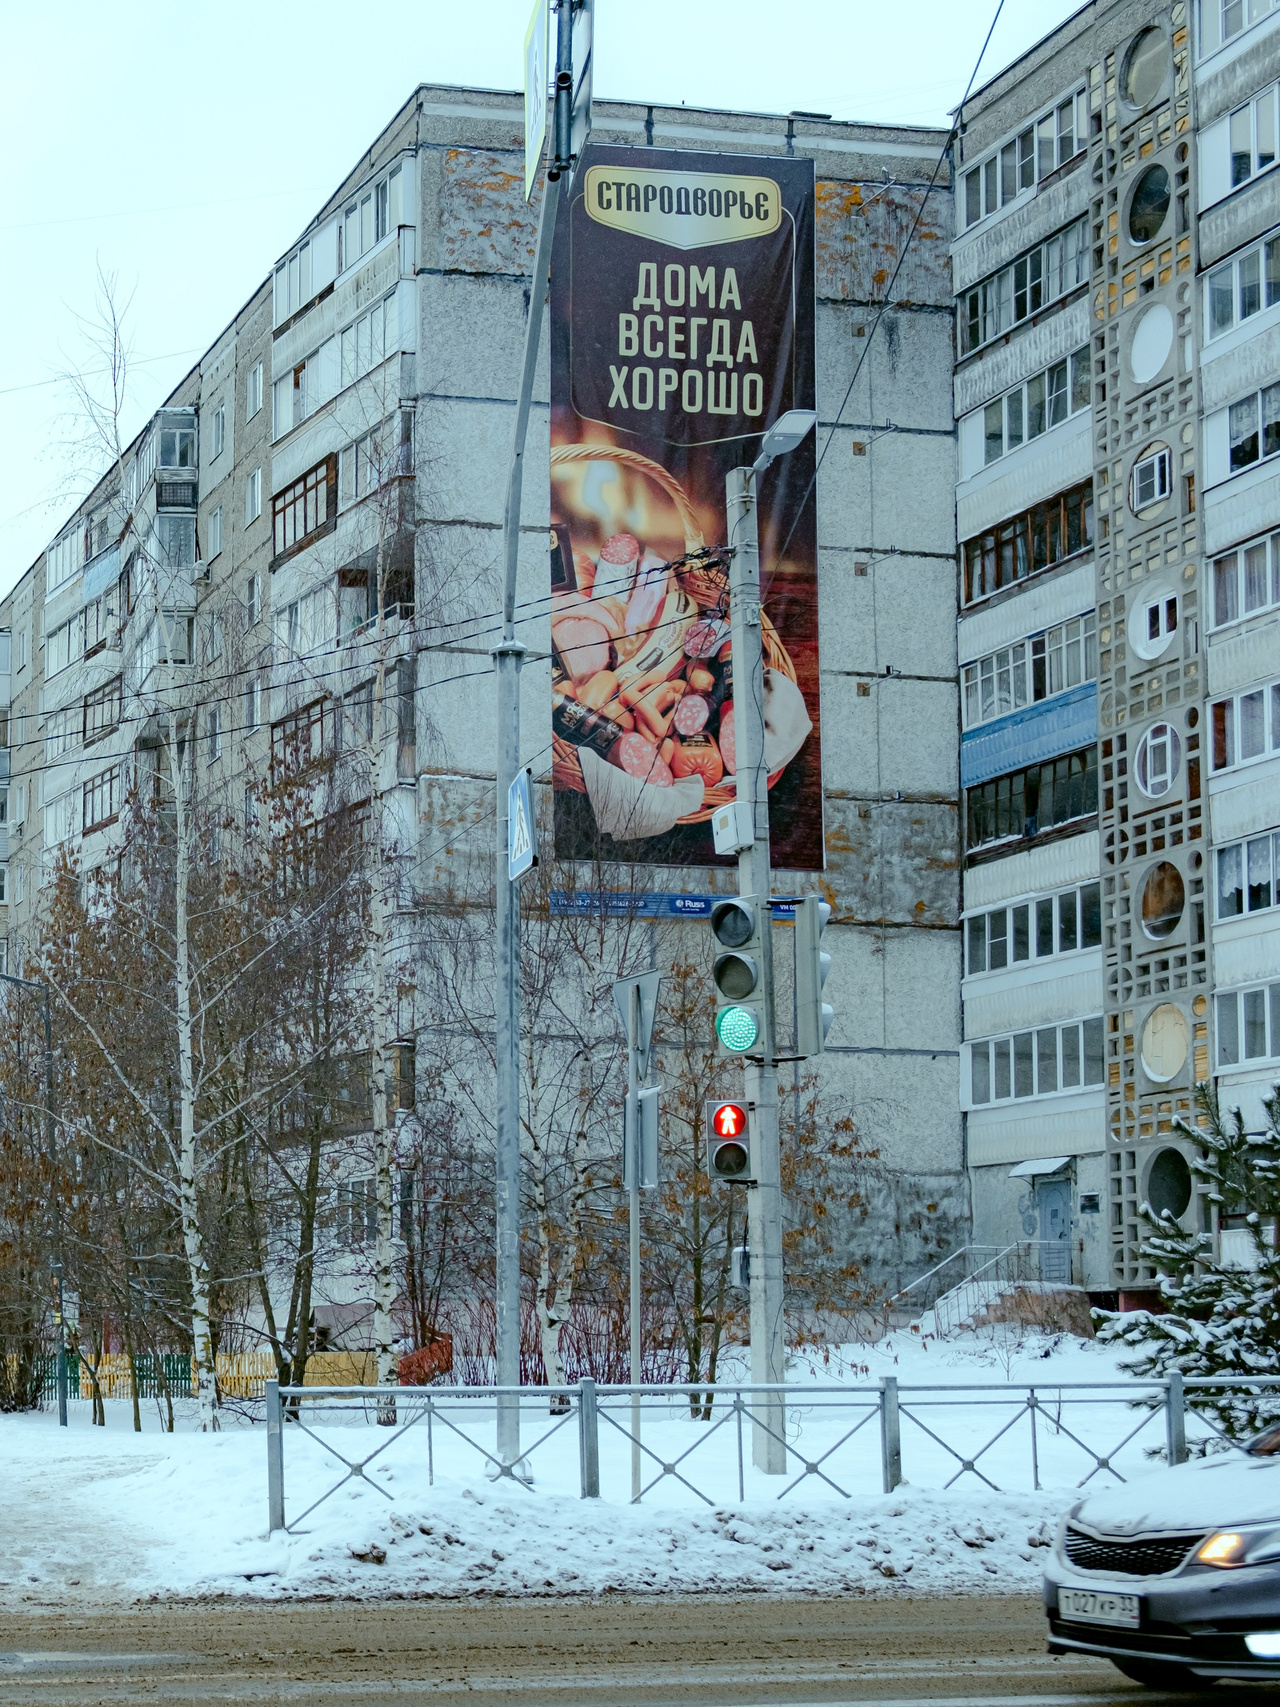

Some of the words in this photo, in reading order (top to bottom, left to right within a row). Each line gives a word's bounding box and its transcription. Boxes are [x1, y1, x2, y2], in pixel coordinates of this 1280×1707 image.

[597, 181, 769, 221] СТАРОДВОРЬЕ
[632, 262, 742, 312] ДОМА
[619, 313, 759, 368] ВСЕГДА
[608, 365, 763, 417] ХОРОШО
[685, 900, 705, 908] Russ
